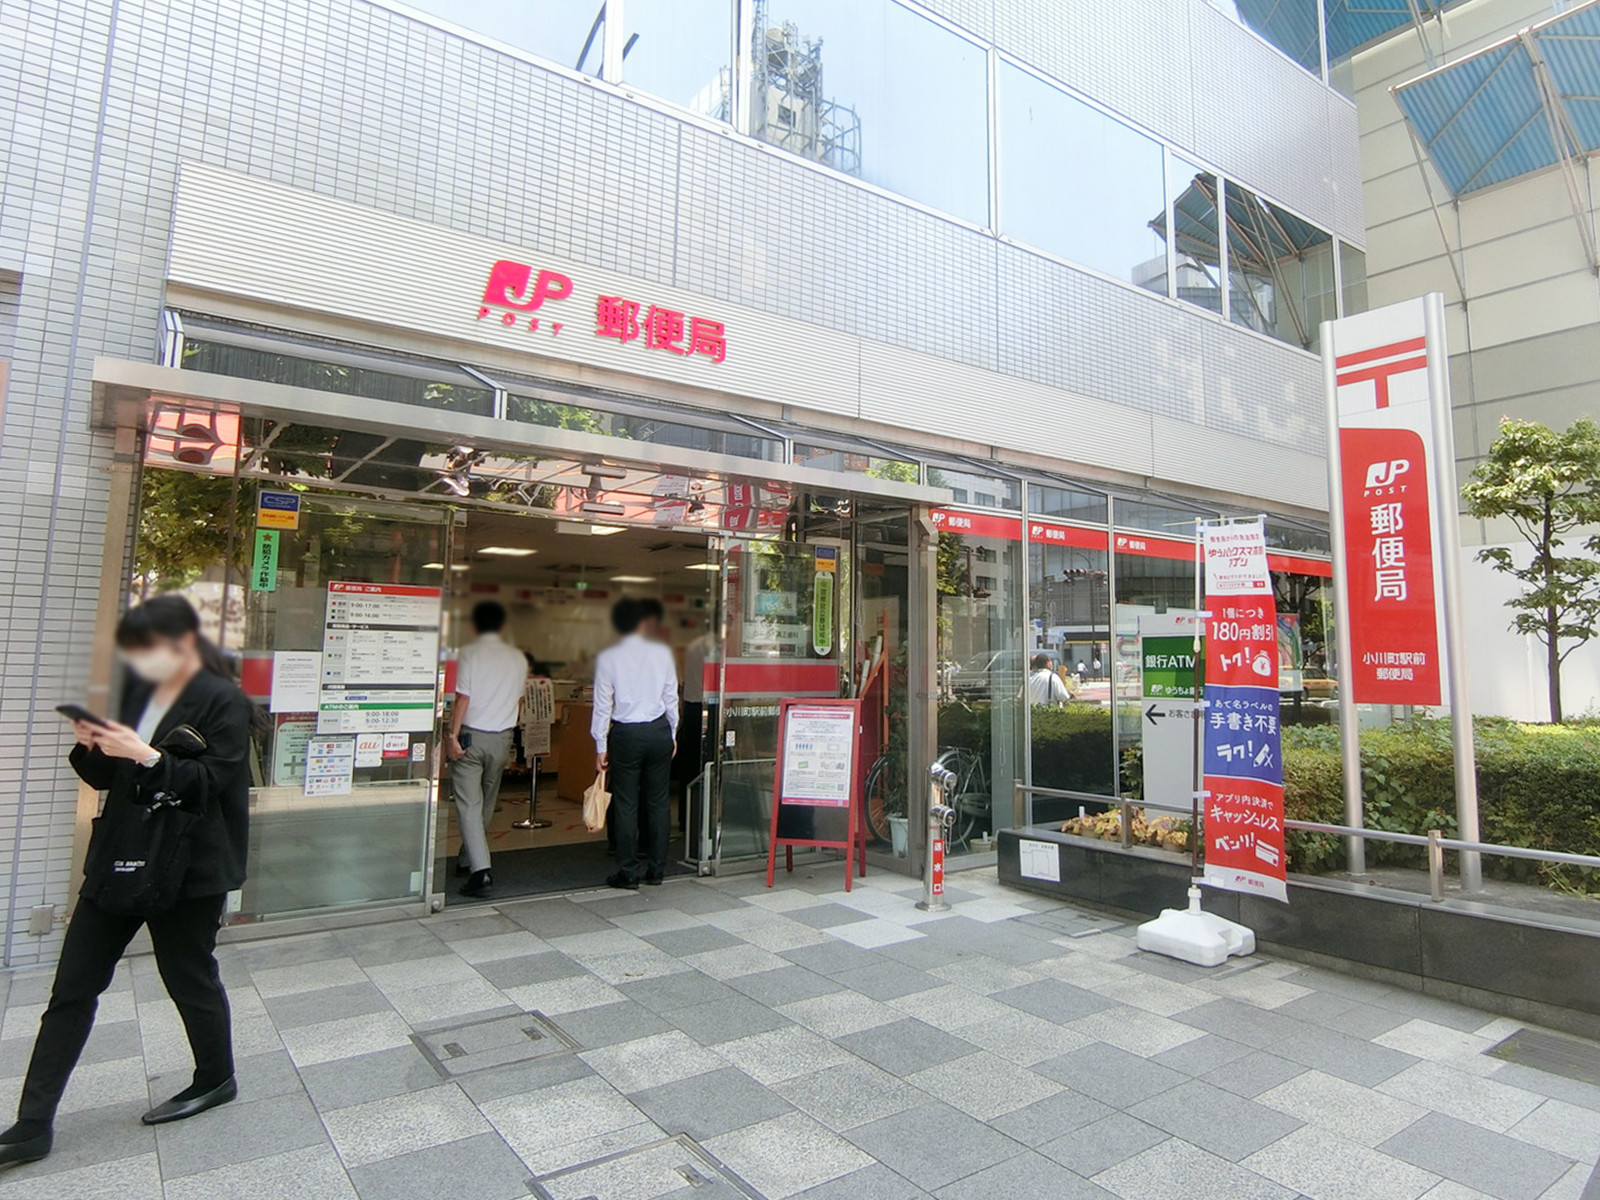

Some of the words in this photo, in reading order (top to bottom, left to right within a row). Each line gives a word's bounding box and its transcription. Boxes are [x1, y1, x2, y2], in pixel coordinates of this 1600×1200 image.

[483, 259, 573, 311] JP
[477, 306, 563, 337] POST
[594, 294, 727, 364] 郵便局
[1365, 459, 1410, 488] JP
[1363, 485, 1407, 498] POST
[948, 516, 972, 529] 郵便局
[1045, 529, 1066, 540] 郵便局
[1129, 540, 1147, 551] 郵便局
[1370, 502, 1408, 602] 郵便局
[1222, 606, 1264, 619] 1個につき
[1212, 621, 1274, 641] 180円割引
[1362, 651, 1426, 665] 小川町駅前
[1376, 667, 1413, 681] 郵便局
[1215, 699, 1273, 712] あて名ラベルの
[1210, 711, 1277, 735] 手書き不要
[360, 741, 380, 750] au
[1216, 793, 1274, 811] アプリ内決済で
[1210, 804, 1280, 832] キャッシュレス
[1215, 832, 1255, 851] ベンリ!
